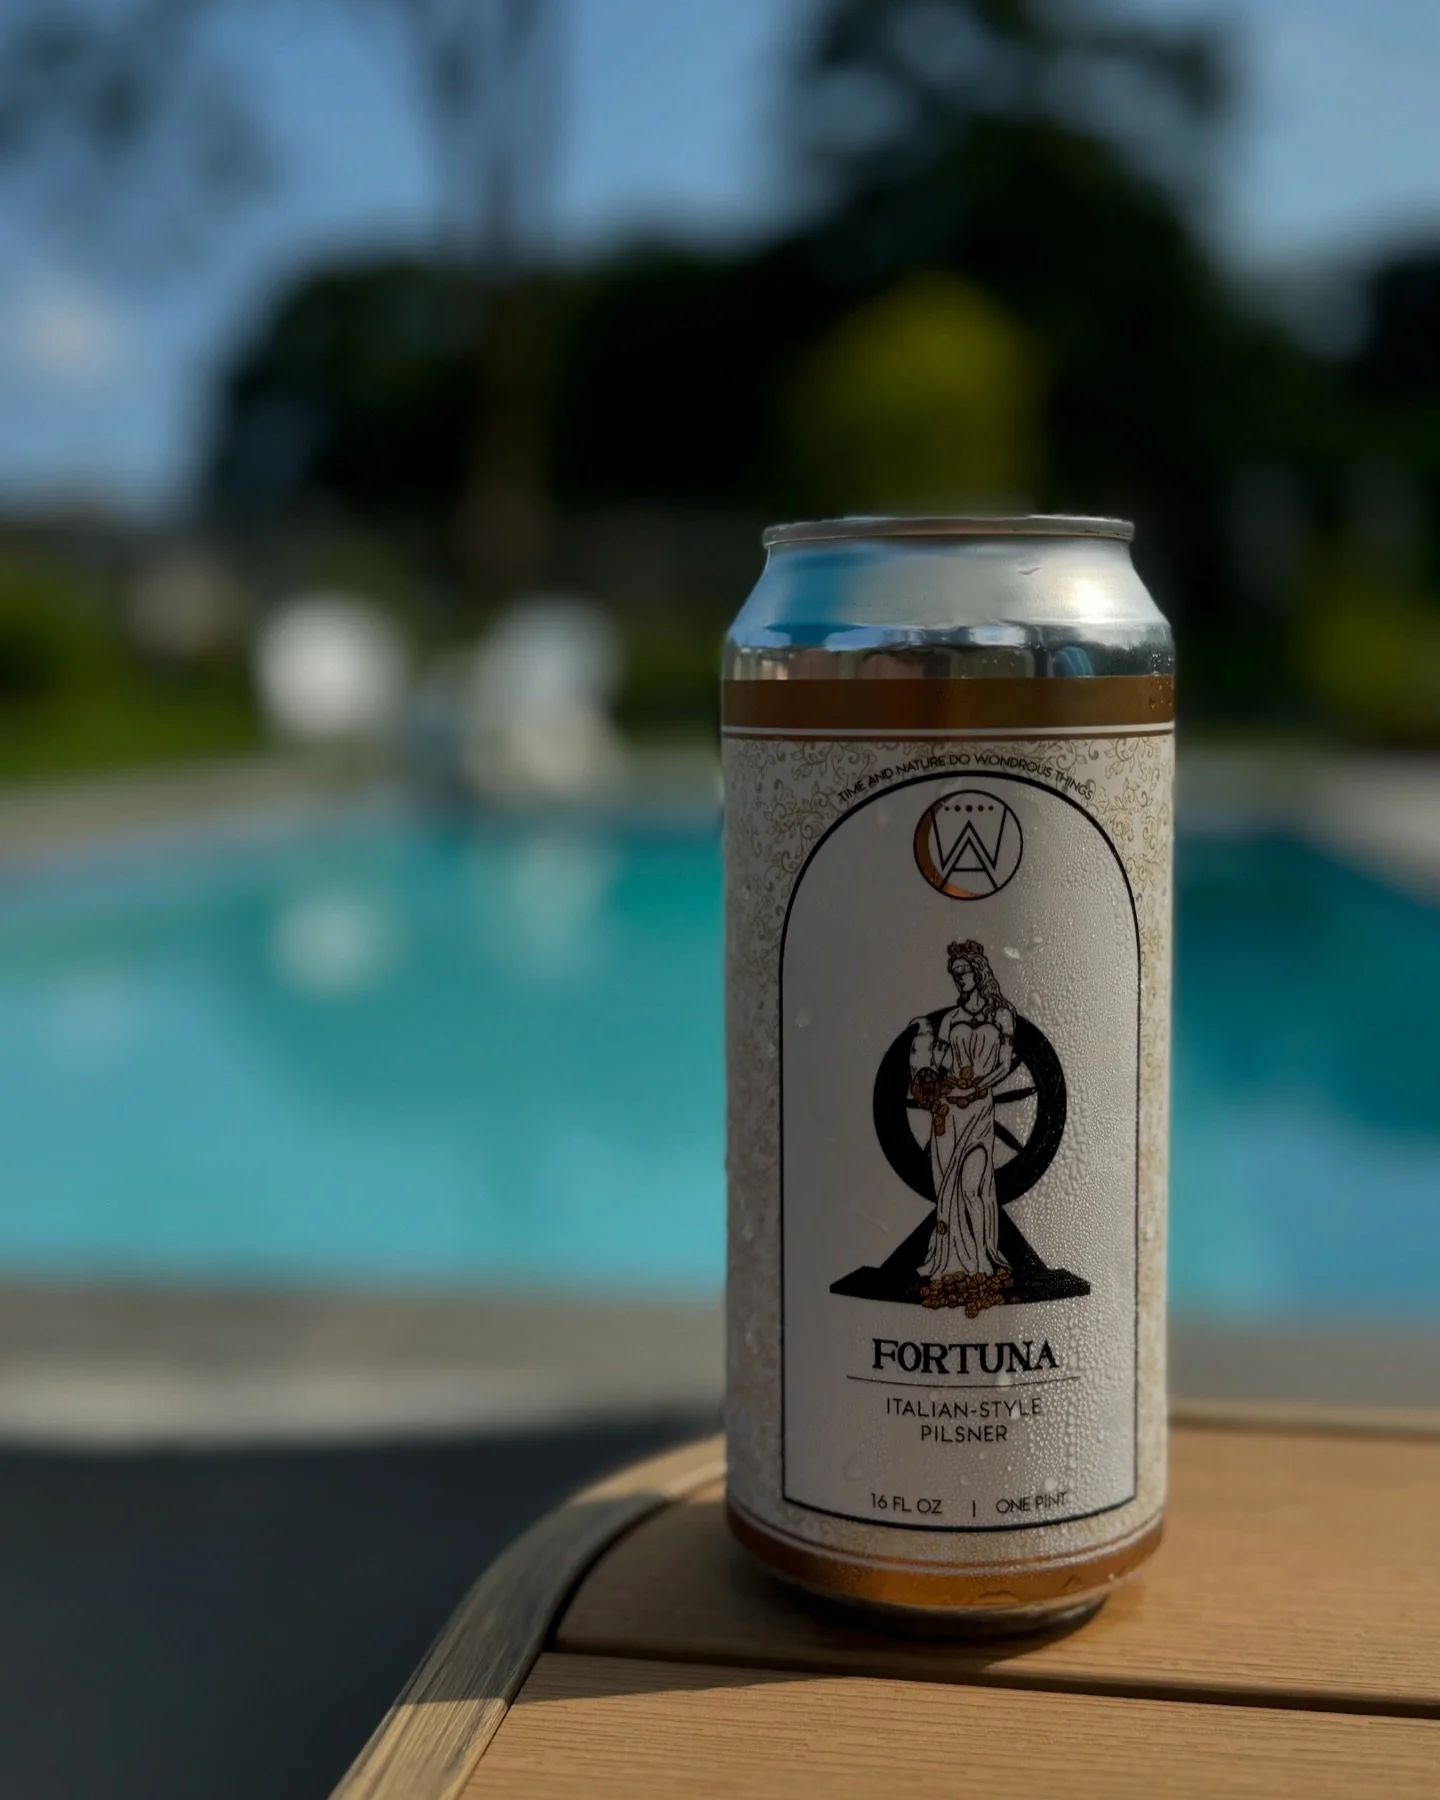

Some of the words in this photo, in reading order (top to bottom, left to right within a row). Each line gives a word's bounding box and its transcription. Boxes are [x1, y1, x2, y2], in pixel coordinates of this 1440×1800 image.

[837, 780, 866, 802] TIME
[868, 767, 894, 787] AND
[895, 755, 946, 776] NATURE
[949, 753, 971, 766] DO
[974, 753, 1054, 778] WONDROUS
[1054, 771, 1094, 801] THINGS
[872, 1337, 1059, 1375] FORTUNA
[886, 1396, 1042, 1419] ITALIAN-STYLE
[921, 1424, 1008, 1443] PILSNER
[871, 1493, 888, 1510] 16
[893, 1496, 912, 1513] FL
[916, 1499, 943, 1514] OZ
[995, 1497, 1031, 1513] ONE
[1034, 1491, 1067, 1509] PINT
